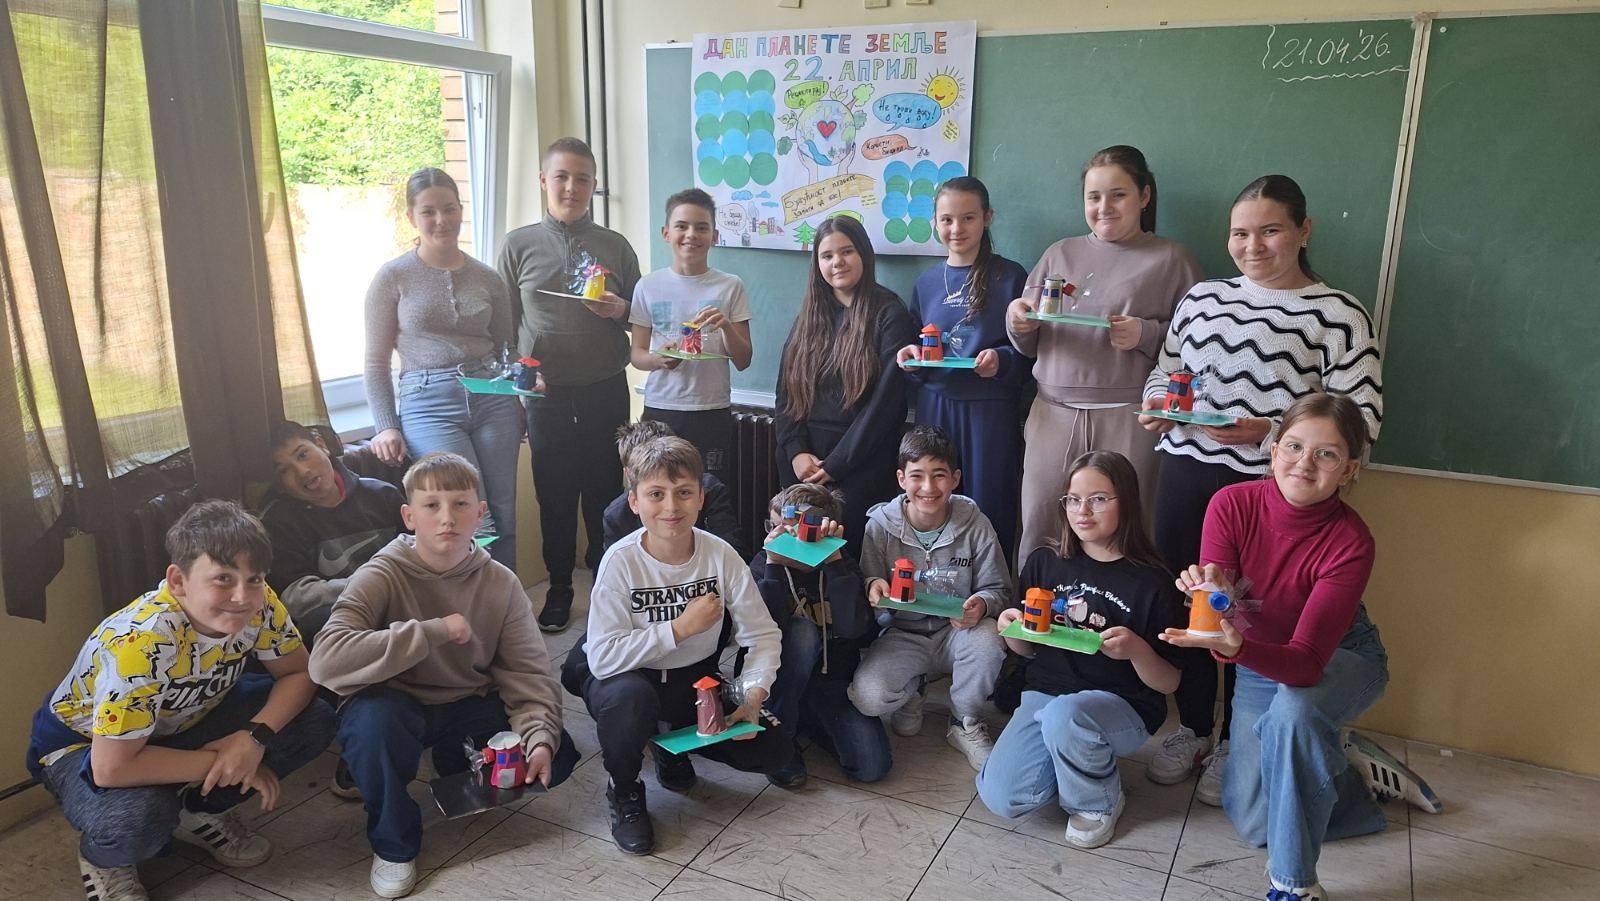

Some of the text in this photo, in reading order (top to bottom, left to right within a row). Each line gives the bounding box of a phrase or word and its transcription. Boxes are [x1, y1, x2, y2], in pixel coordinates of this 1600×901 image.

[703, 31, 947, 60] ДАН ПЛАНЕТЕ ЗЕМЉЕ
[783, 55, 917, 81] 22. АПРИЛ
[879, 99, 889, 111] Не
[630, 579, 720, 610] STRANGER
[645, 604, 688, 623] THIN
